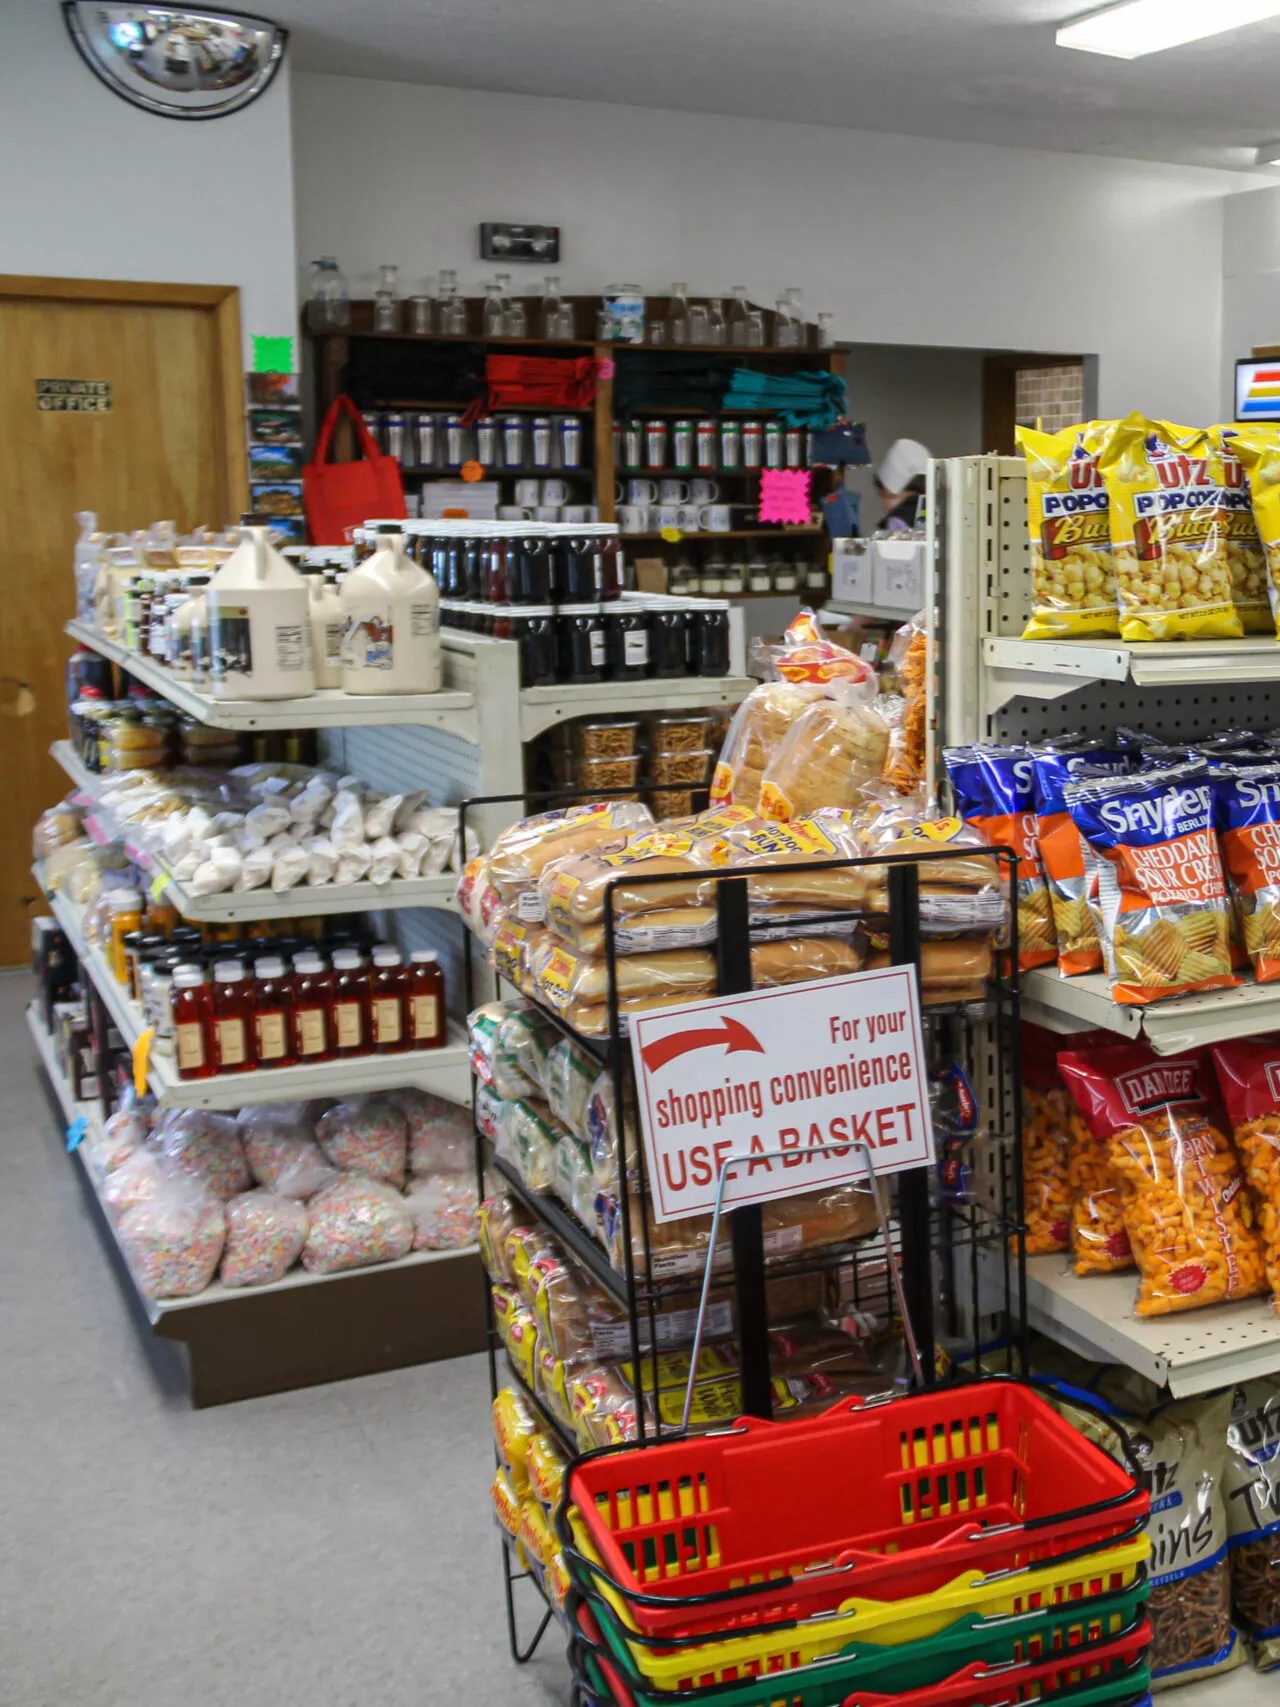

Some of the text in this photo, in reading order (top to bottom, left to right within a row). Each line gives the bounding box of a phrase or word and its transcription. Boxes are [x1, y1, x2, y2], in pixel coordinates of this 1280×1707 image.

[38, 396, 107, 410] OFFICE
[1100, 785, 1211, 837] Snyder
[1131, 836, 1210, 868] CHEDDAR
[1134, 862, 1180, 891] SOUR
[829, 1010, 907, 1044] For your
[656, 1052, 912, 1129] shopping convenience
[663, 1102, 916, 1192] USE A BASKET
